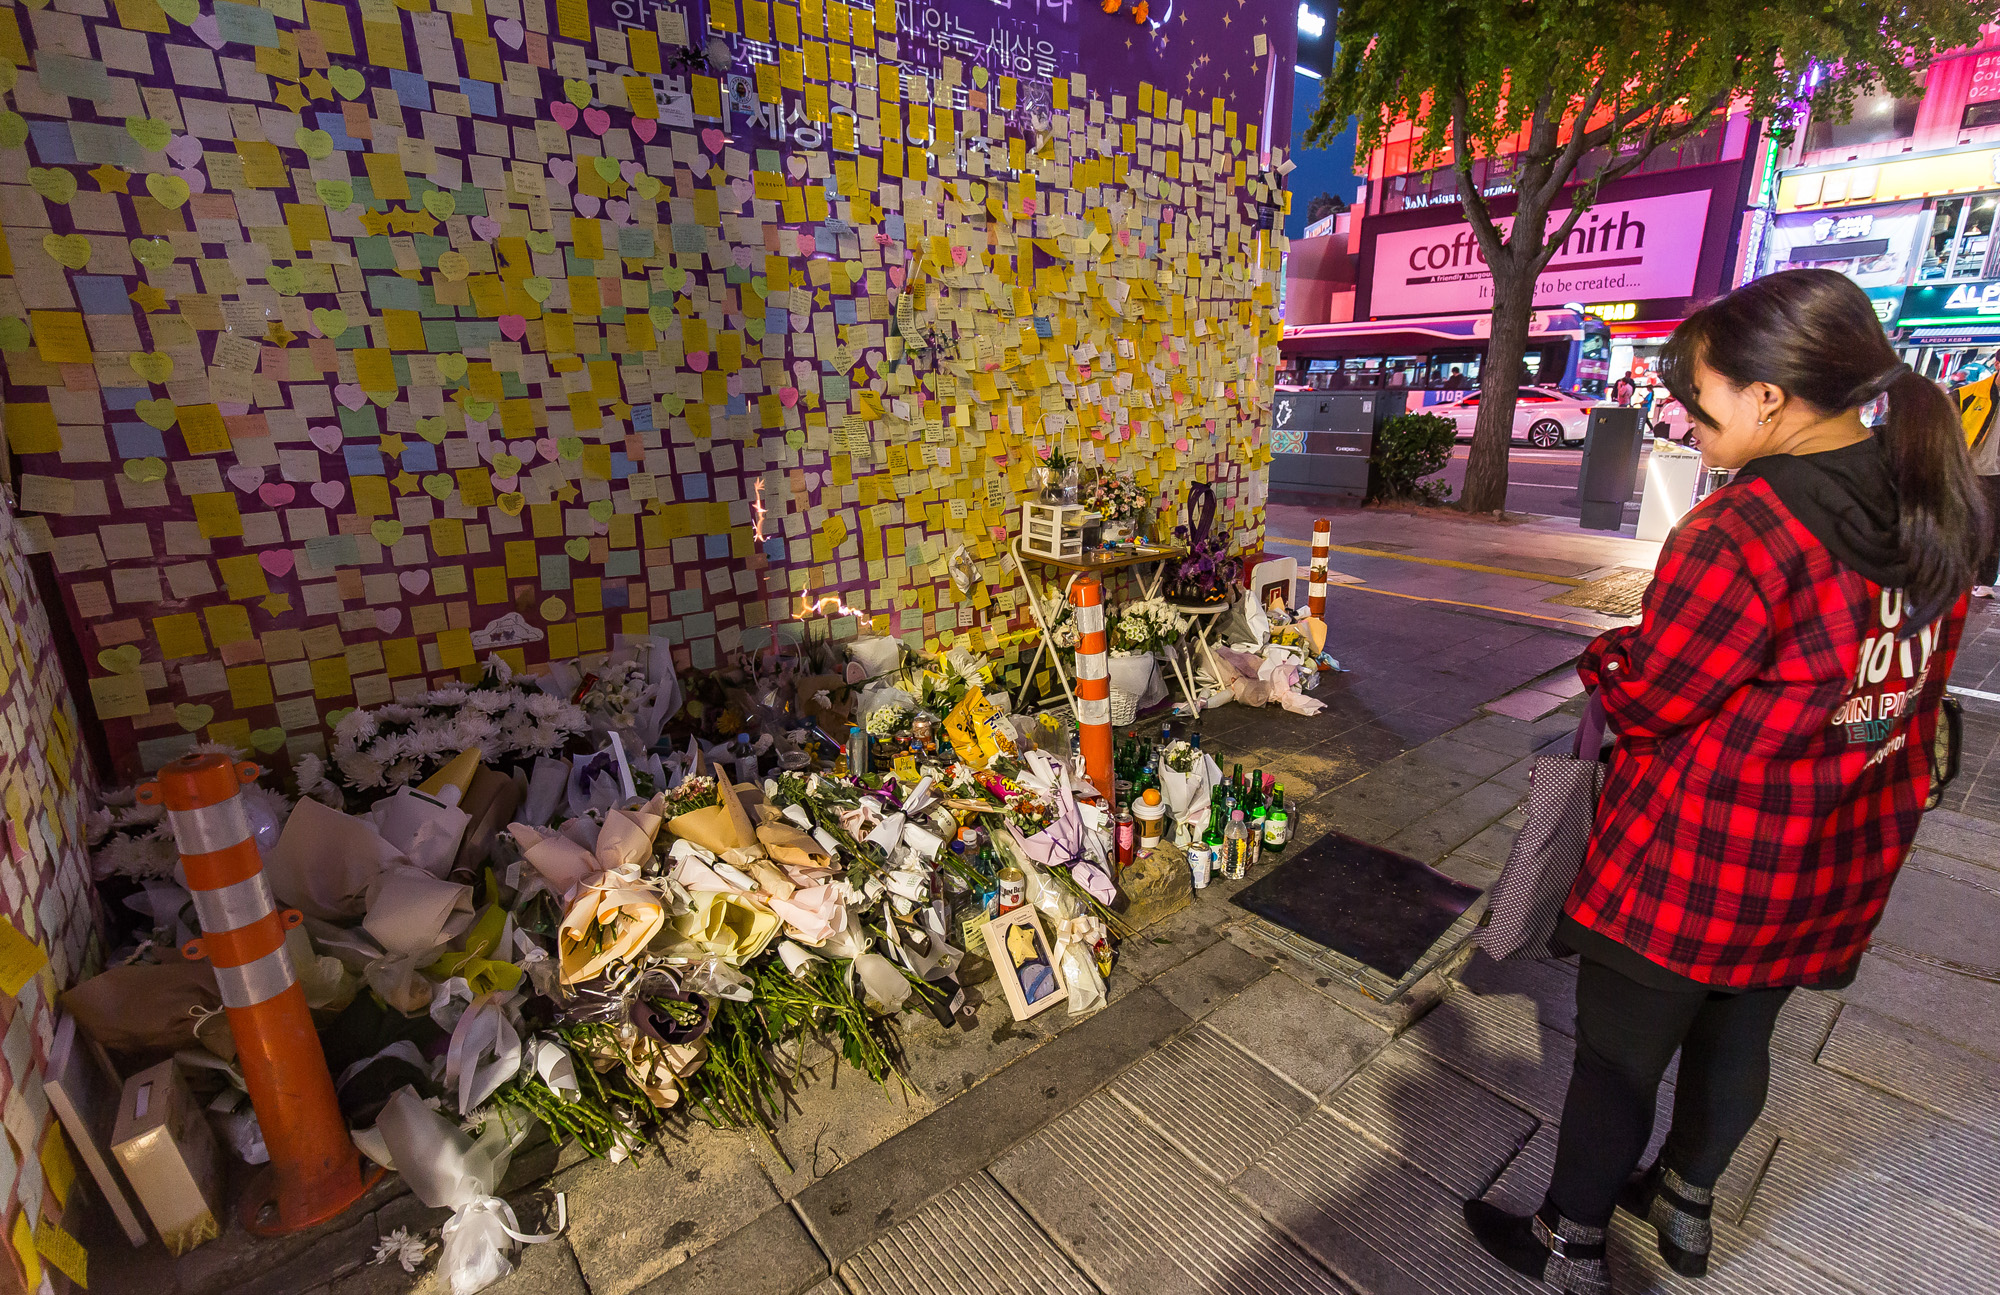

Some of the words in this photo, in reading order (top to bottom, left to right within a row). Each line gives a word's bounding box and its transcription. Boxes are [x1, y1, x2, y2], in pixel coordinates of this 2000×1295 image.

[985, 27, 1057, 79] 세상을
[1976, 54, 2000, 68] Larg
[1409, 210, 1646, 272] coffmith
[1541, 281, 1554, 294] to
[1557, 278, 1572, 292] be
[1944, 282, 2000, 306] ALP
